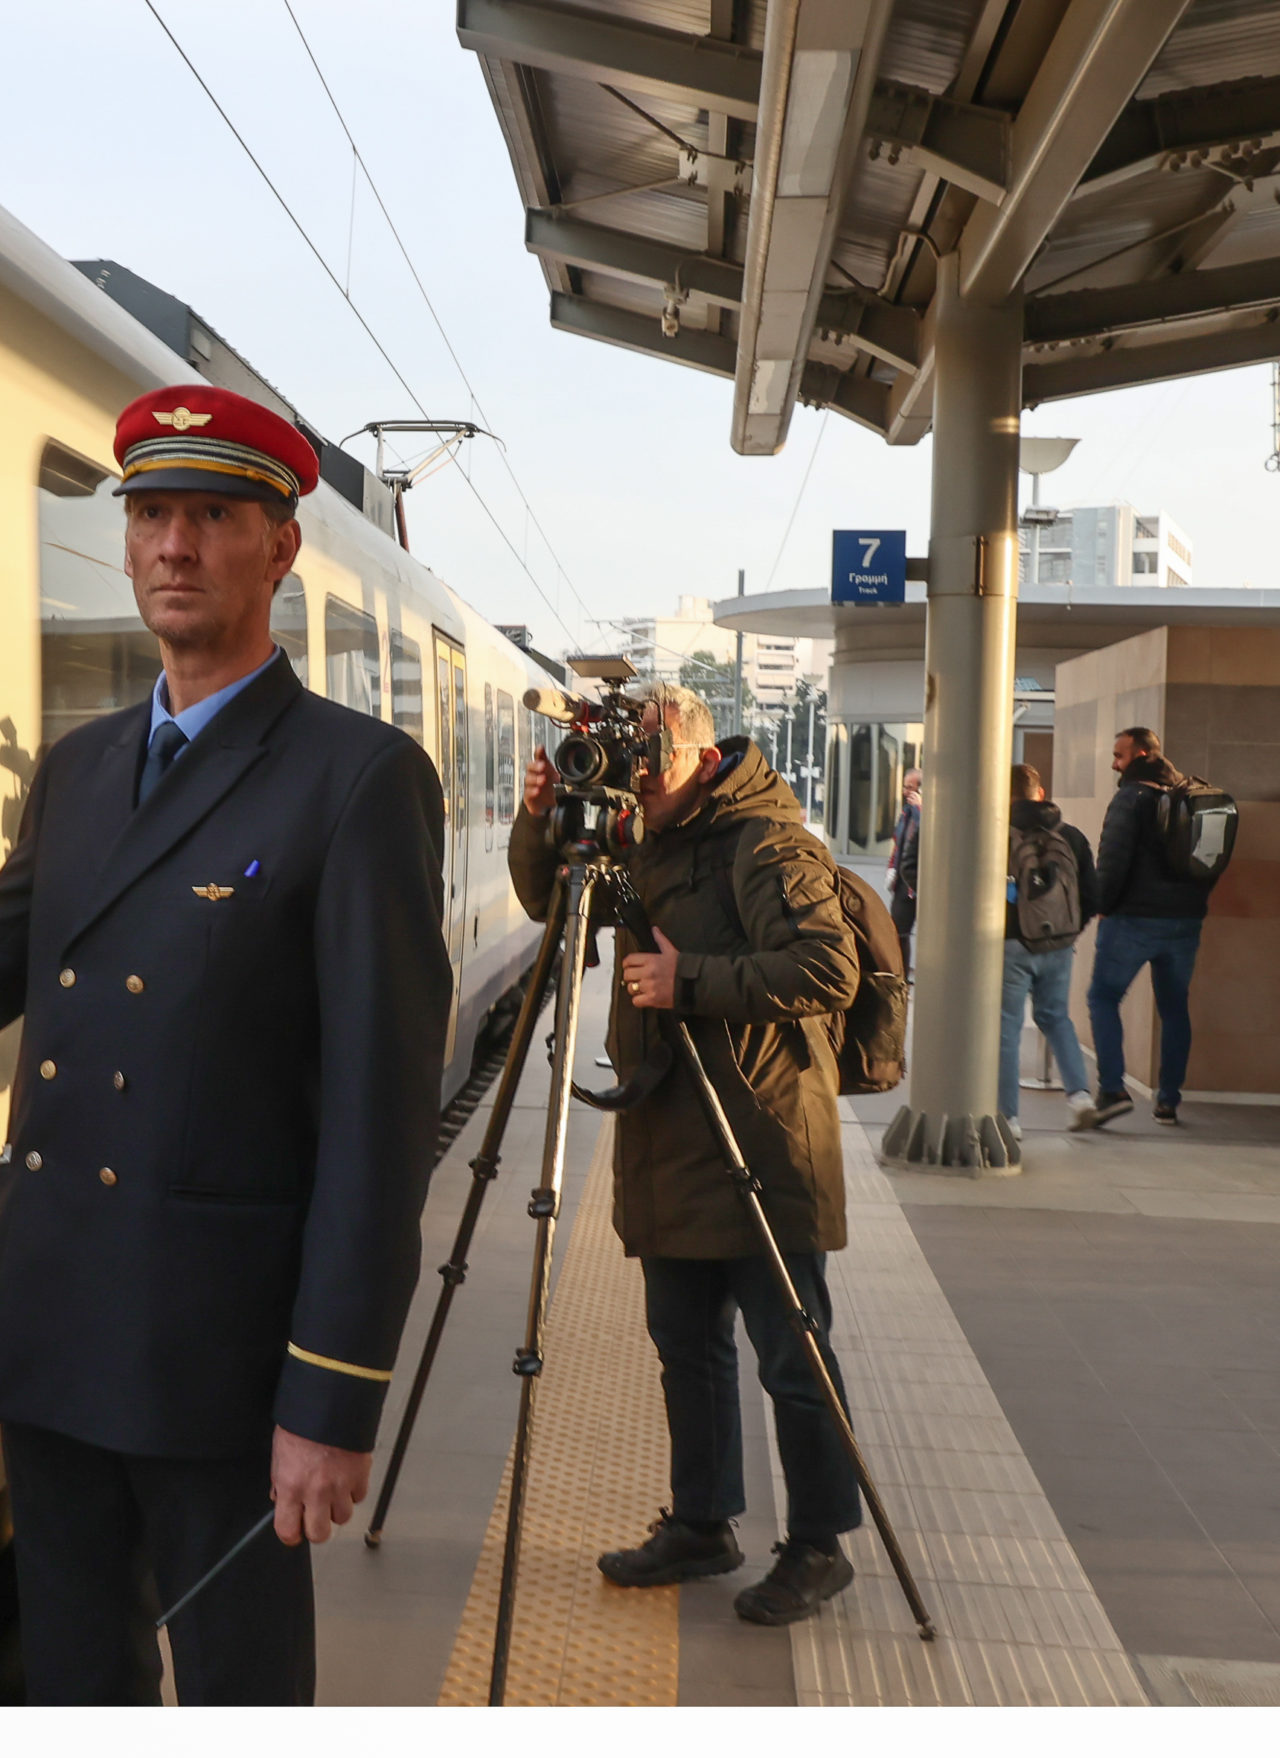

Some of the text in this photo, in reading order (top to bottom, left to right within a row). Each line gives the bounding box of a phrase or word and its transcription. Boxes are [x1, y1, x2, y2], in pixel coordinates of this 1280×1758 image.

[858, 537, 881, 568] 7
[848, 572, 888, 585] Γραμμή
[858, 586, 878, 594] Track
